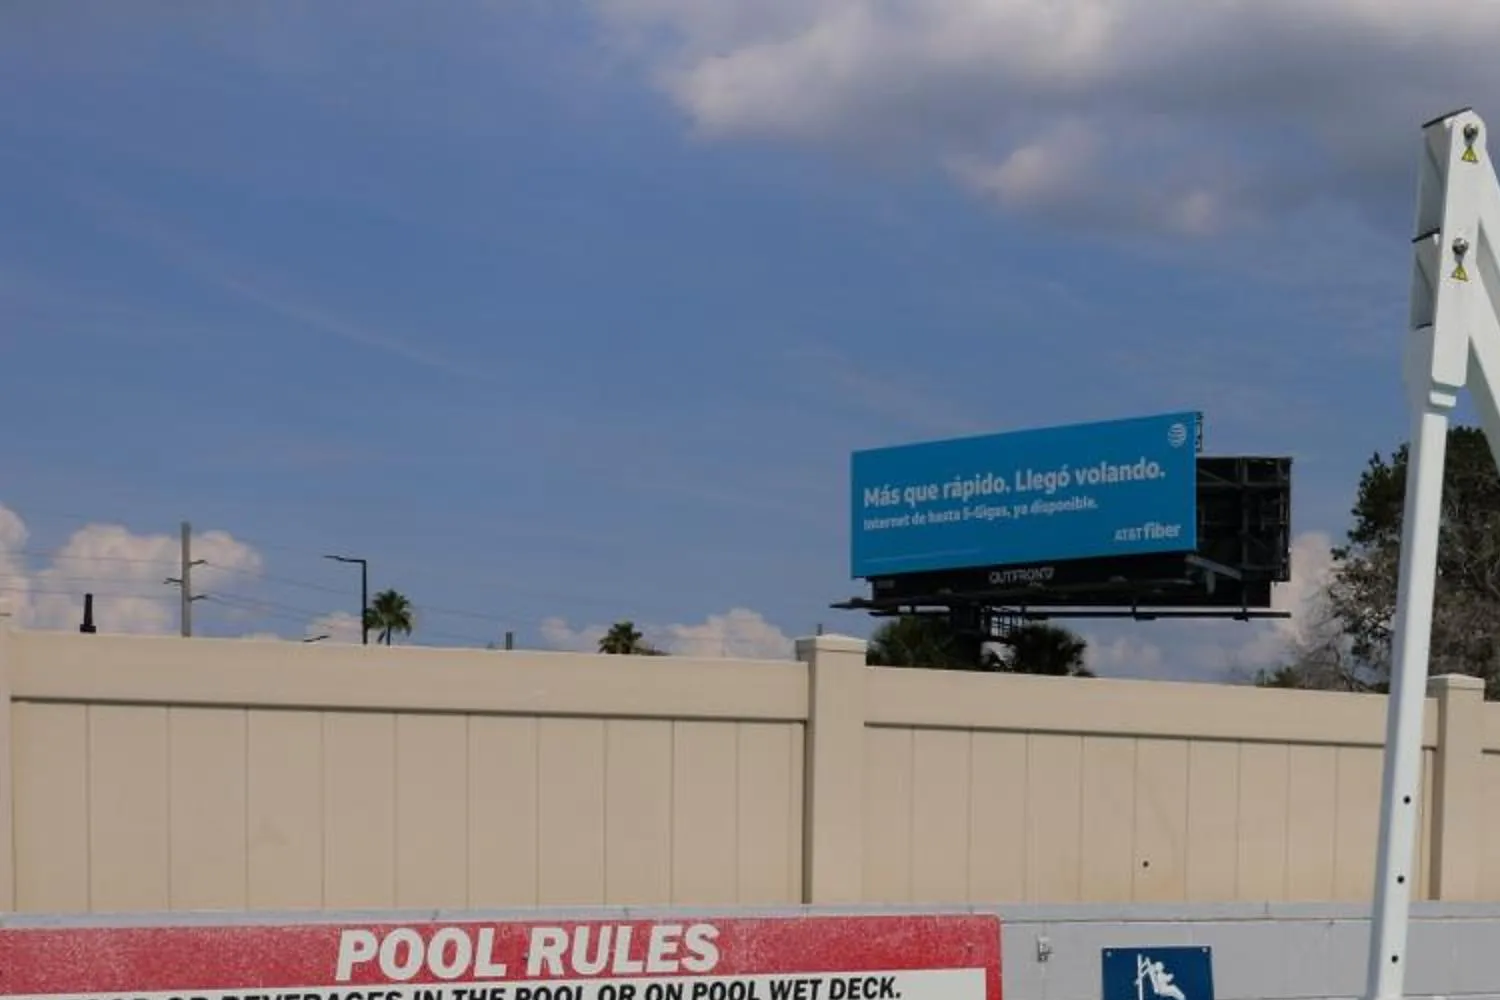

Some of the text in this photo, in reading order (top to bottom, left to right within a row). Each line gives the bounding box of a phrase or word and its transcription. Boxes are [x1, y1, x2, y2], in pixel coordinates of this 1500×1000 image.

[864, 456, 1166, 508] Más que rápido. Llegó volando.
[912, 512, 927, 526] de
[928, 509, 961, 524] hasta
[1013, 504, 1028, 519] ya
[1030, 495, 1099, 515] disponible.
[1114, 521, 1181, 542] AT&T fiber
[335, 923, 720, 982] POOL RULES
[828, 976, 901, 1000] DECK.
